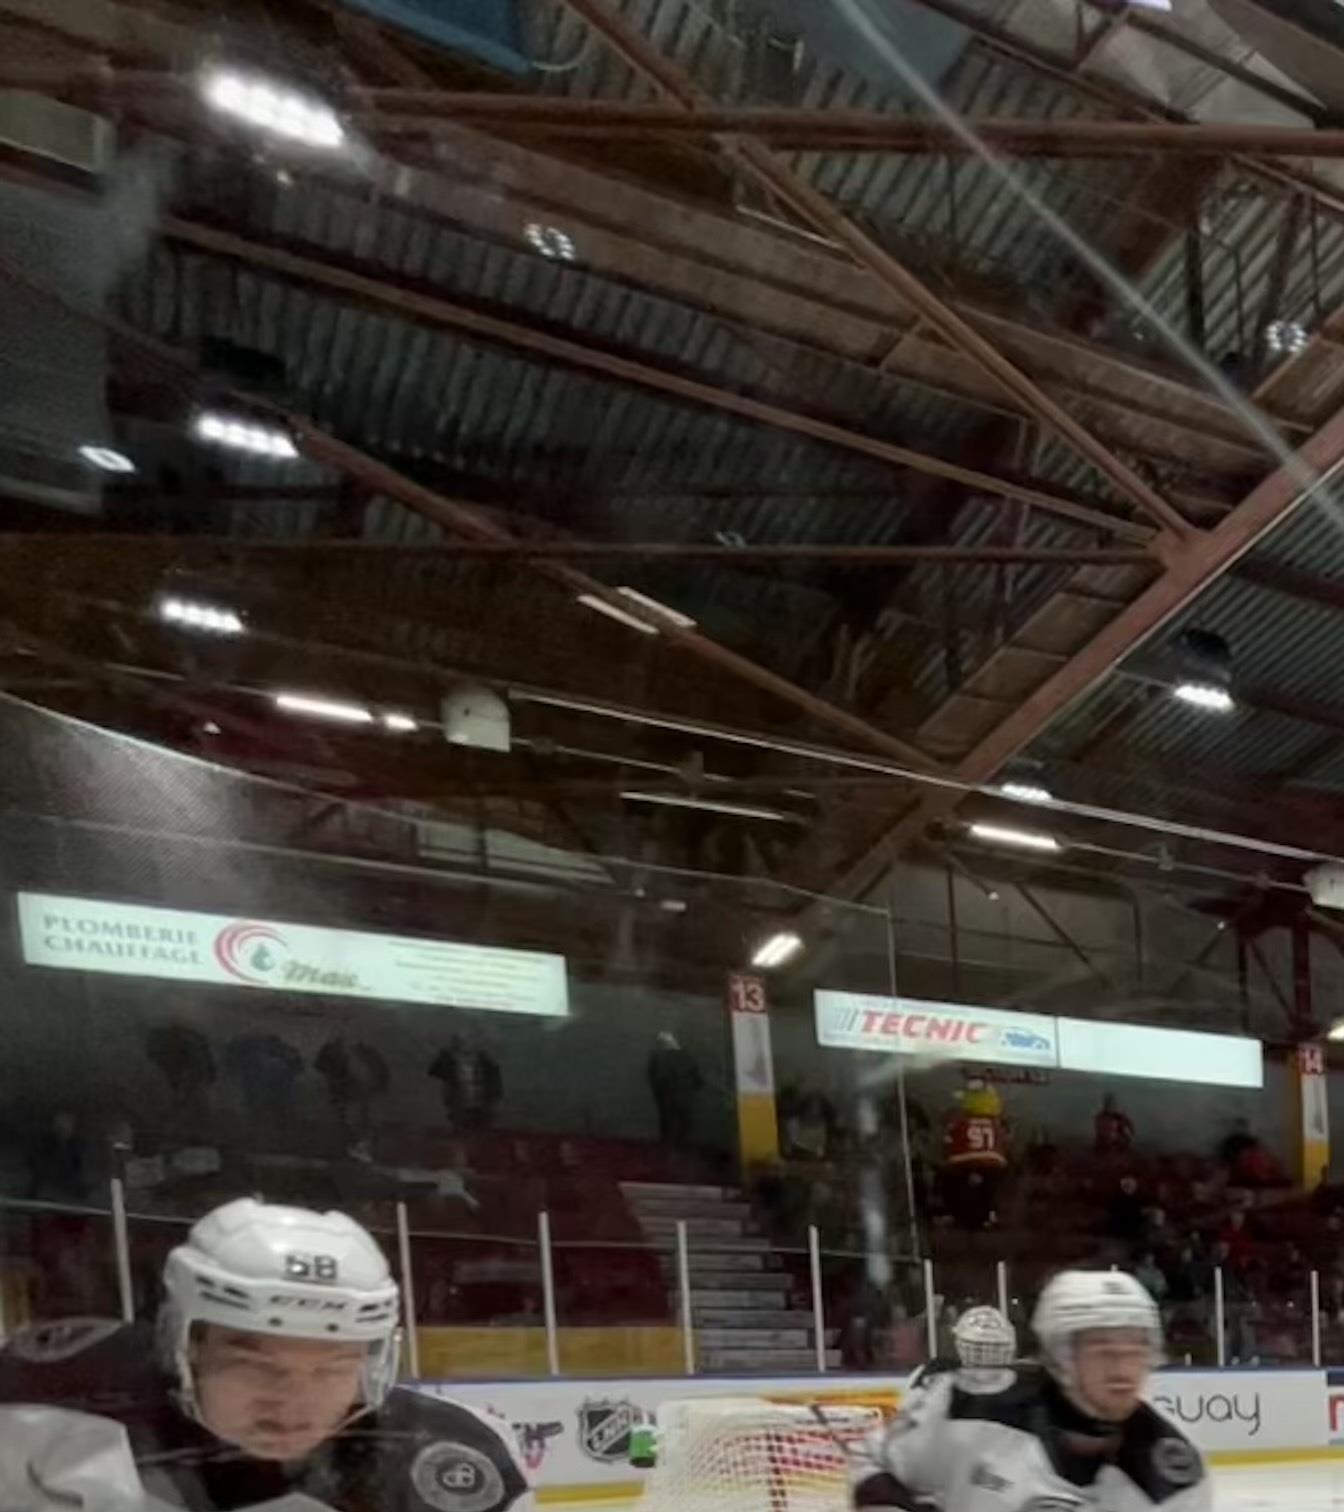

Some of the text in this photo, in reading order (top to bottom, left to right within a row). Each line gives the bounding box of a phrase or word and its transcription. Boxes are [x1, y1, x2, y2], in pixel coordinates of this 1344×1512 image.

[43, 914, 199, 945] PLOMBERIE
[44, 936, 204, 965] CHAUFFAGE
[861, 1010, 987, 1044] TECNIC
